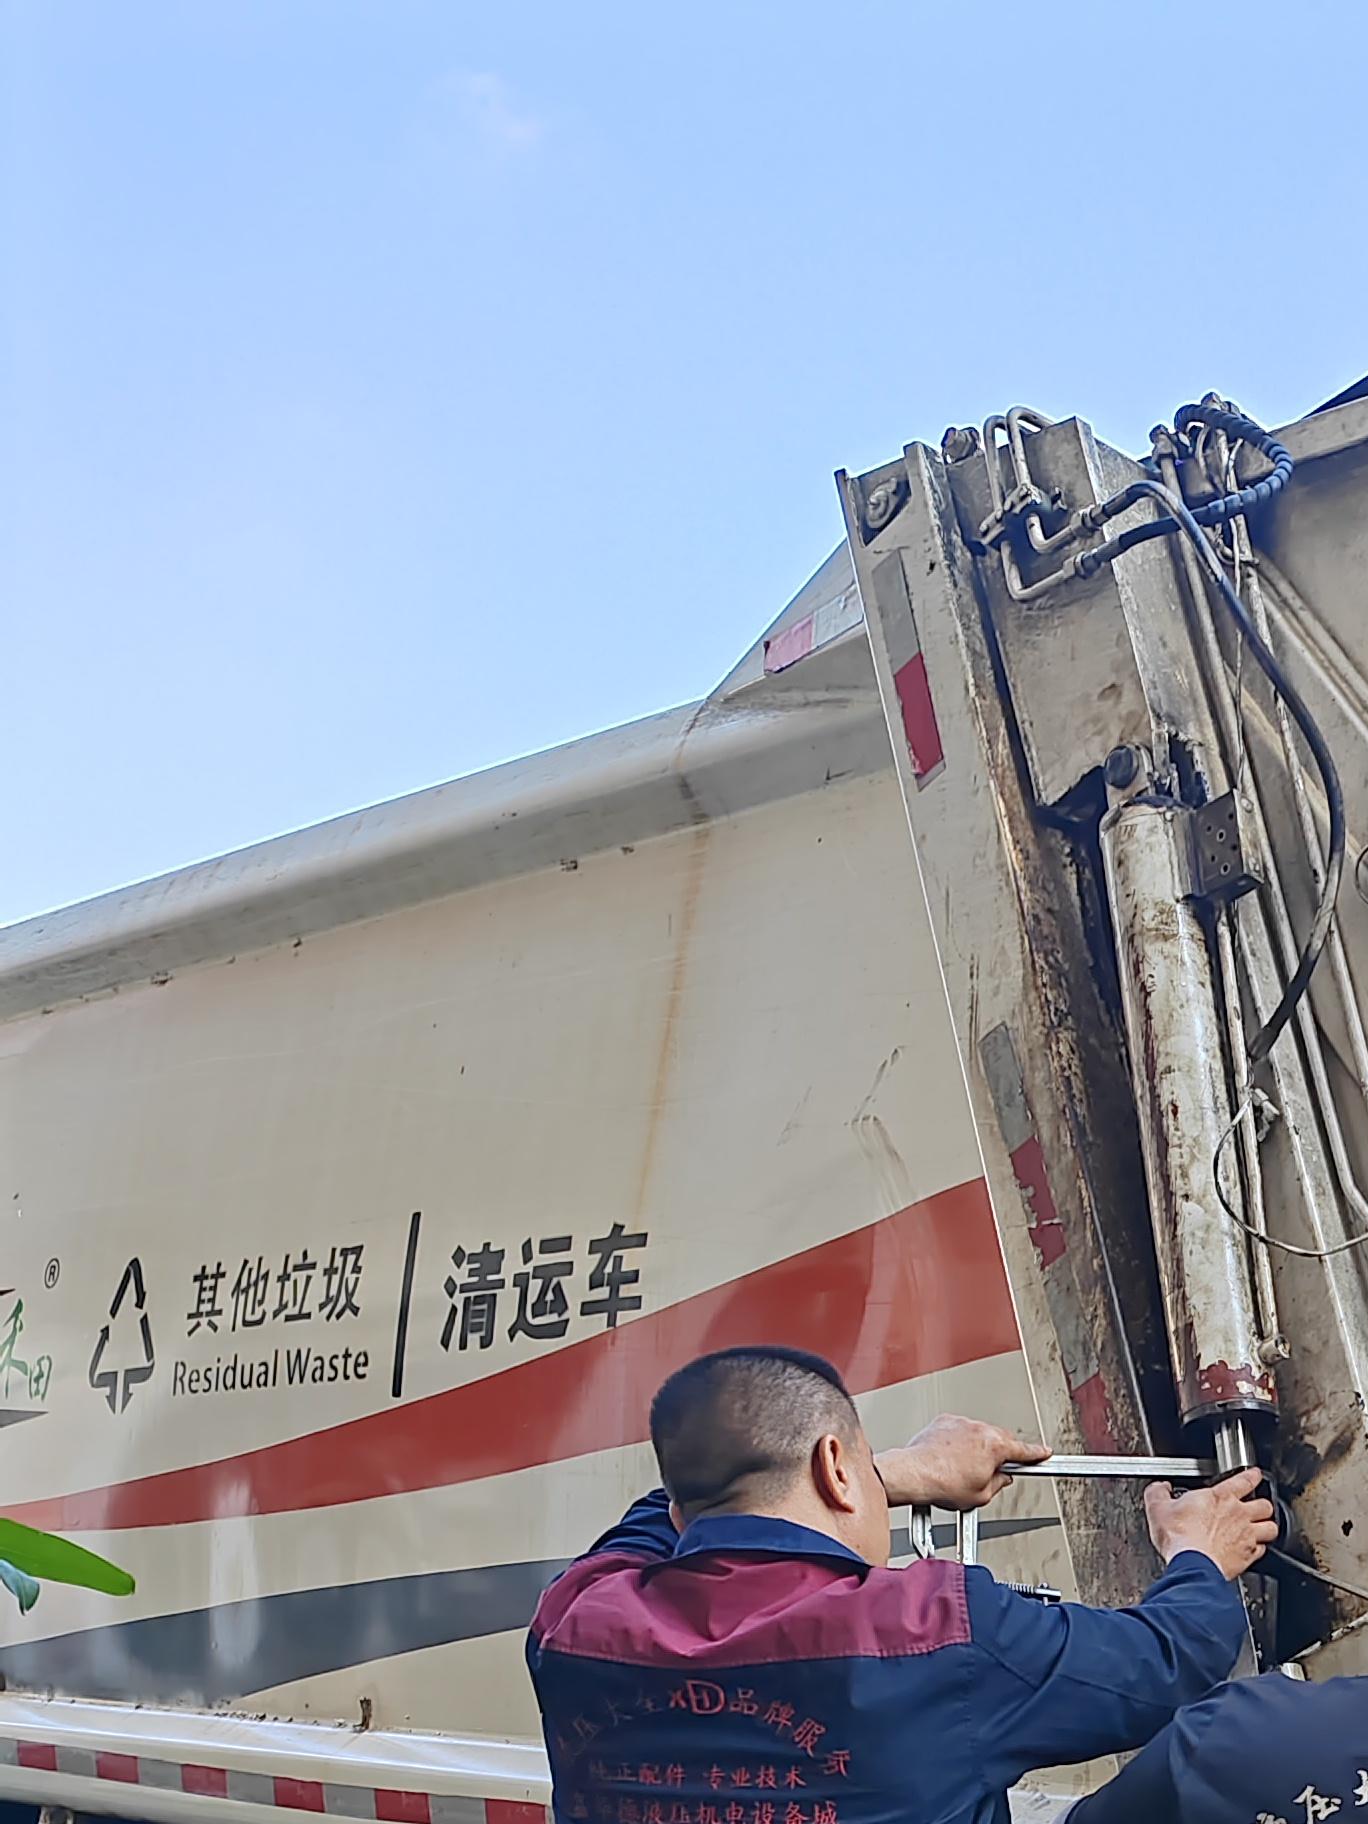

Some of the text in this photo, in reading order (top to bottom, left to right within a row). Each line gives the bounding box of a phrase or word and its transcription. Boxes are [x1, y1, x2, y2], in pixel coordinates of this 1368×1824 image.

[186, 1243, 365, 1338] 其他垃圾
[440, 1222, 649, 1353] 清运车
[172, 1345, 370, 1397] Residual Waste
[702, 1763, 807, 1790] 专业技术
